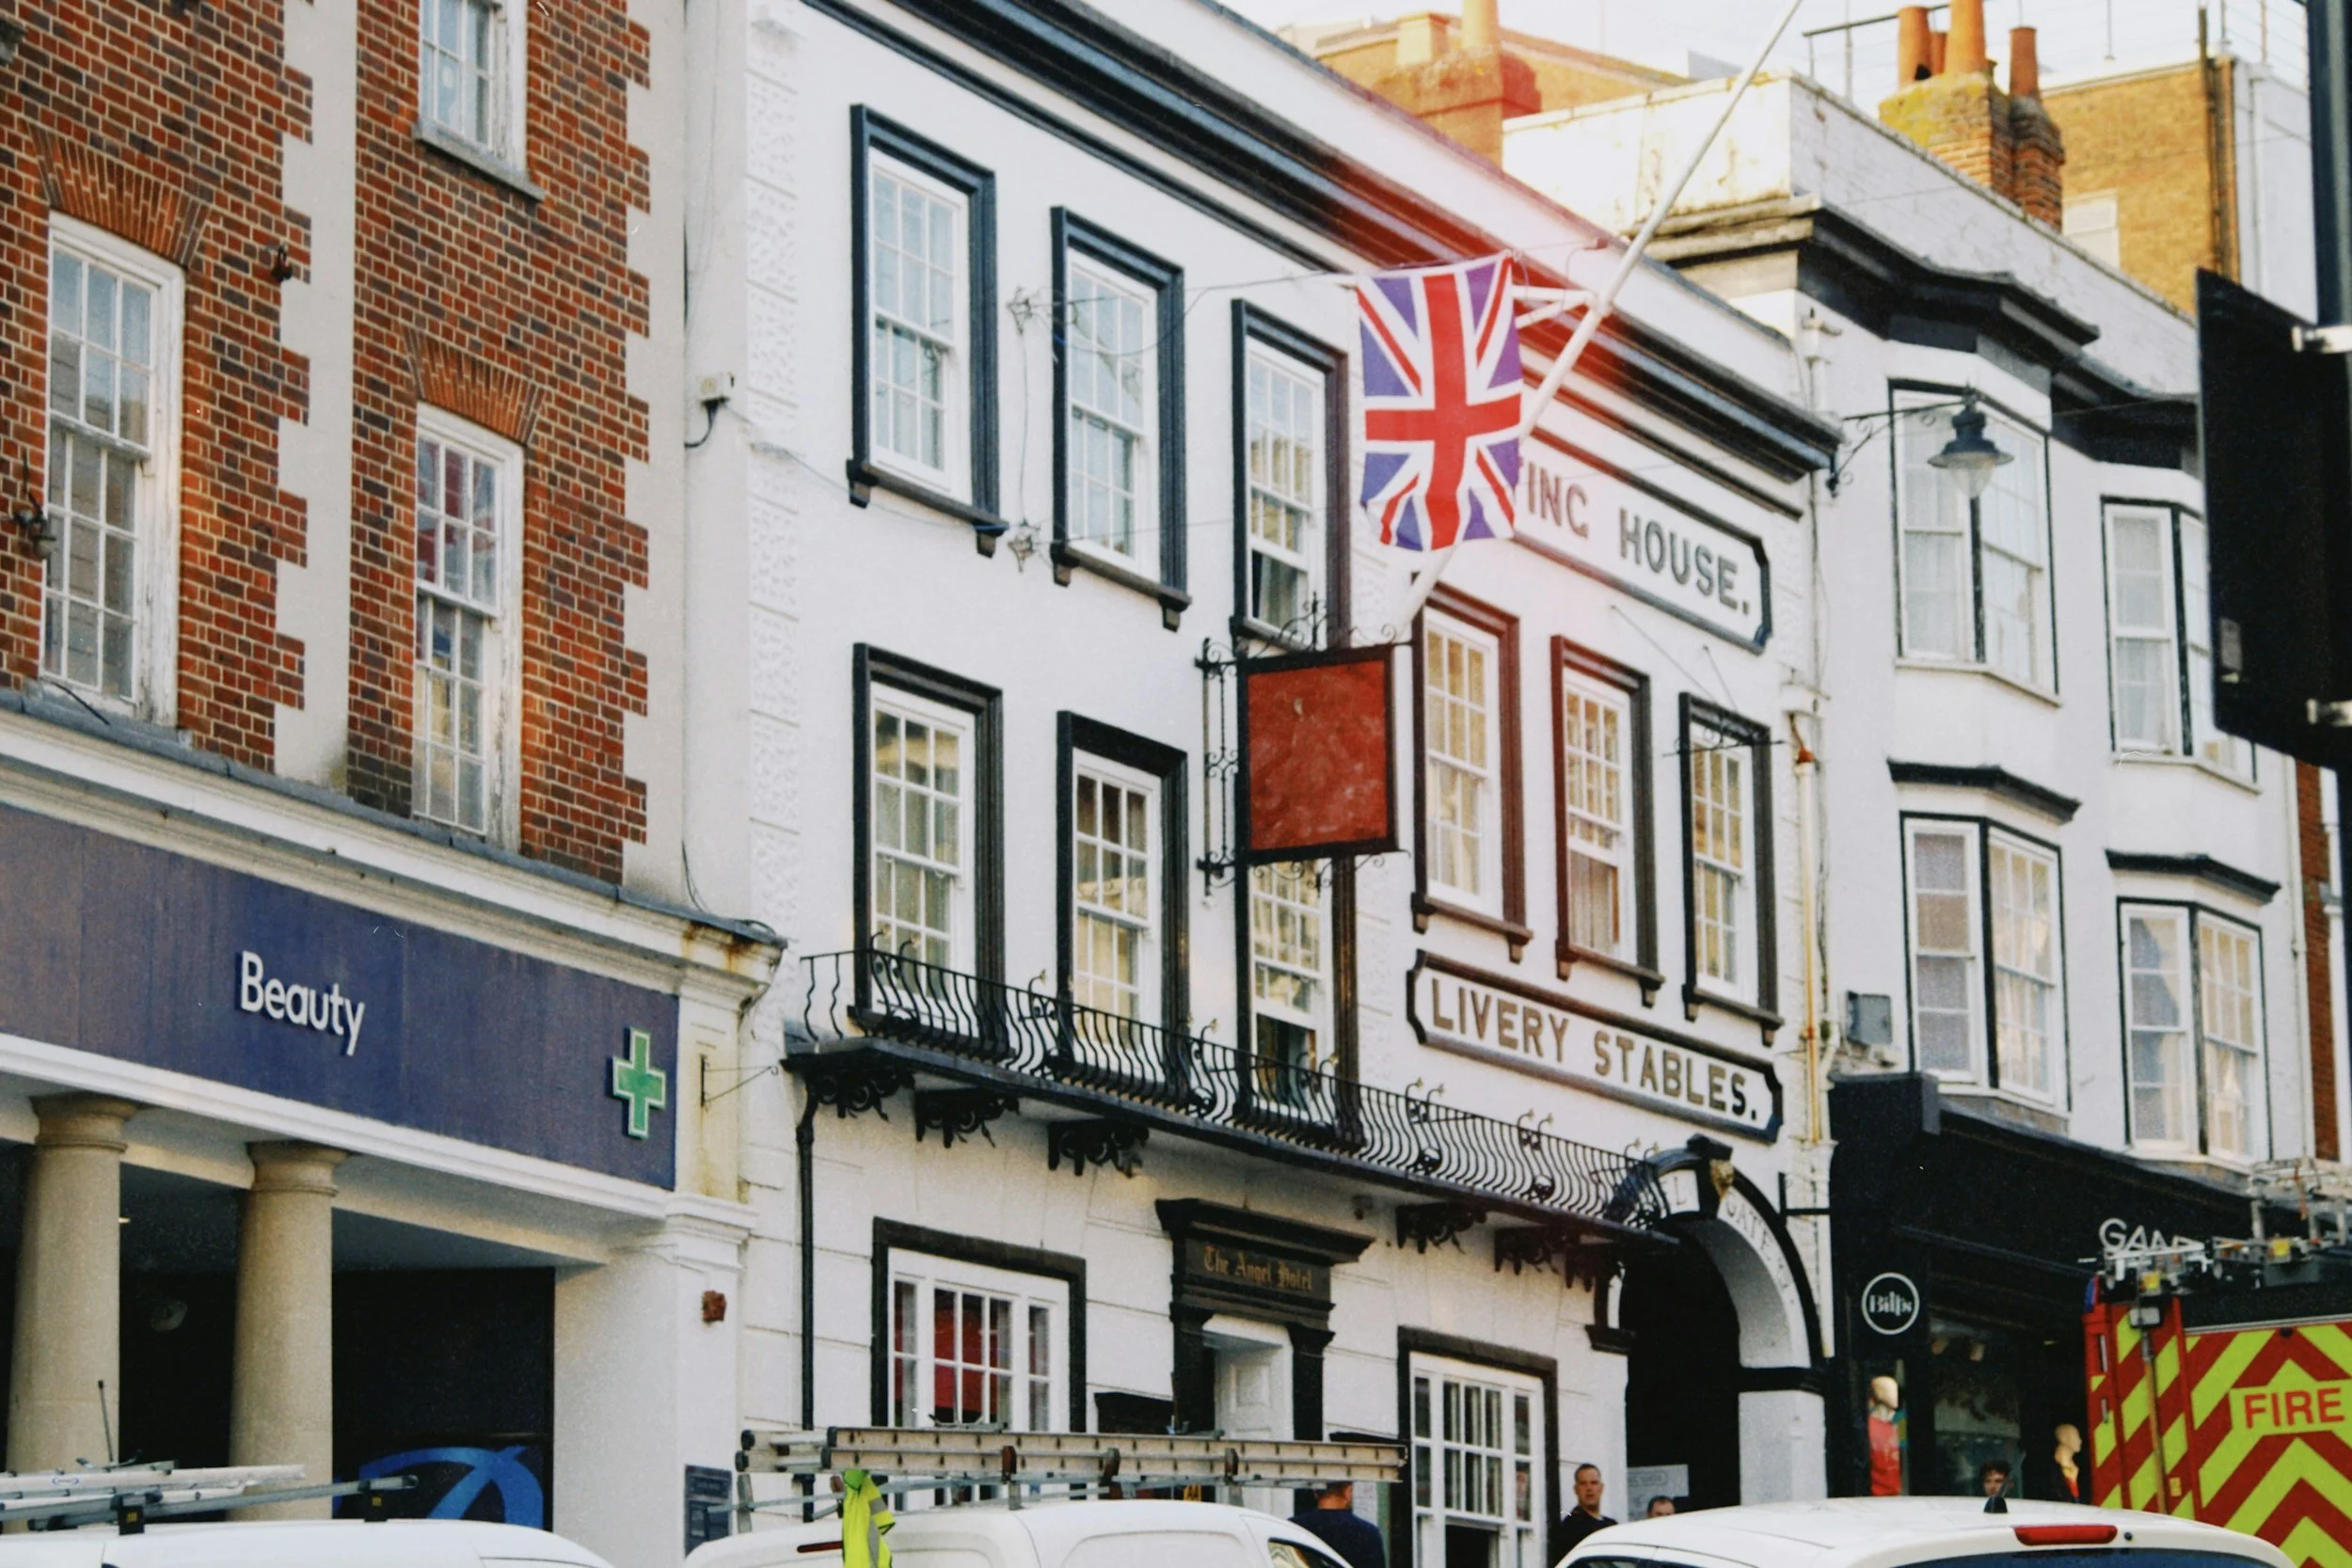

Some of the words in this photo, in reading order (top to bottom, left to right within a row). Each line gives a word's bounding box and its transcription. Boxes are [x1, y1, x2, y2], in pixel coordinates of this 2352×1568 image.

[1618, 506, 1750, 615] HOUSE.
[240, 950, 366, 1056] Beauty
[1431, 976, 1569, 1064] LIVERY
[1593, 1030, 1758, 1121] STABLES.
[1203, 1244, 1230, 1275] The
[1234, 1250, 1272, 1285] Angel
[1278, 1259, 1313, 1291] Hotel
[2244, 1386, 2345, 1430] FIRE
